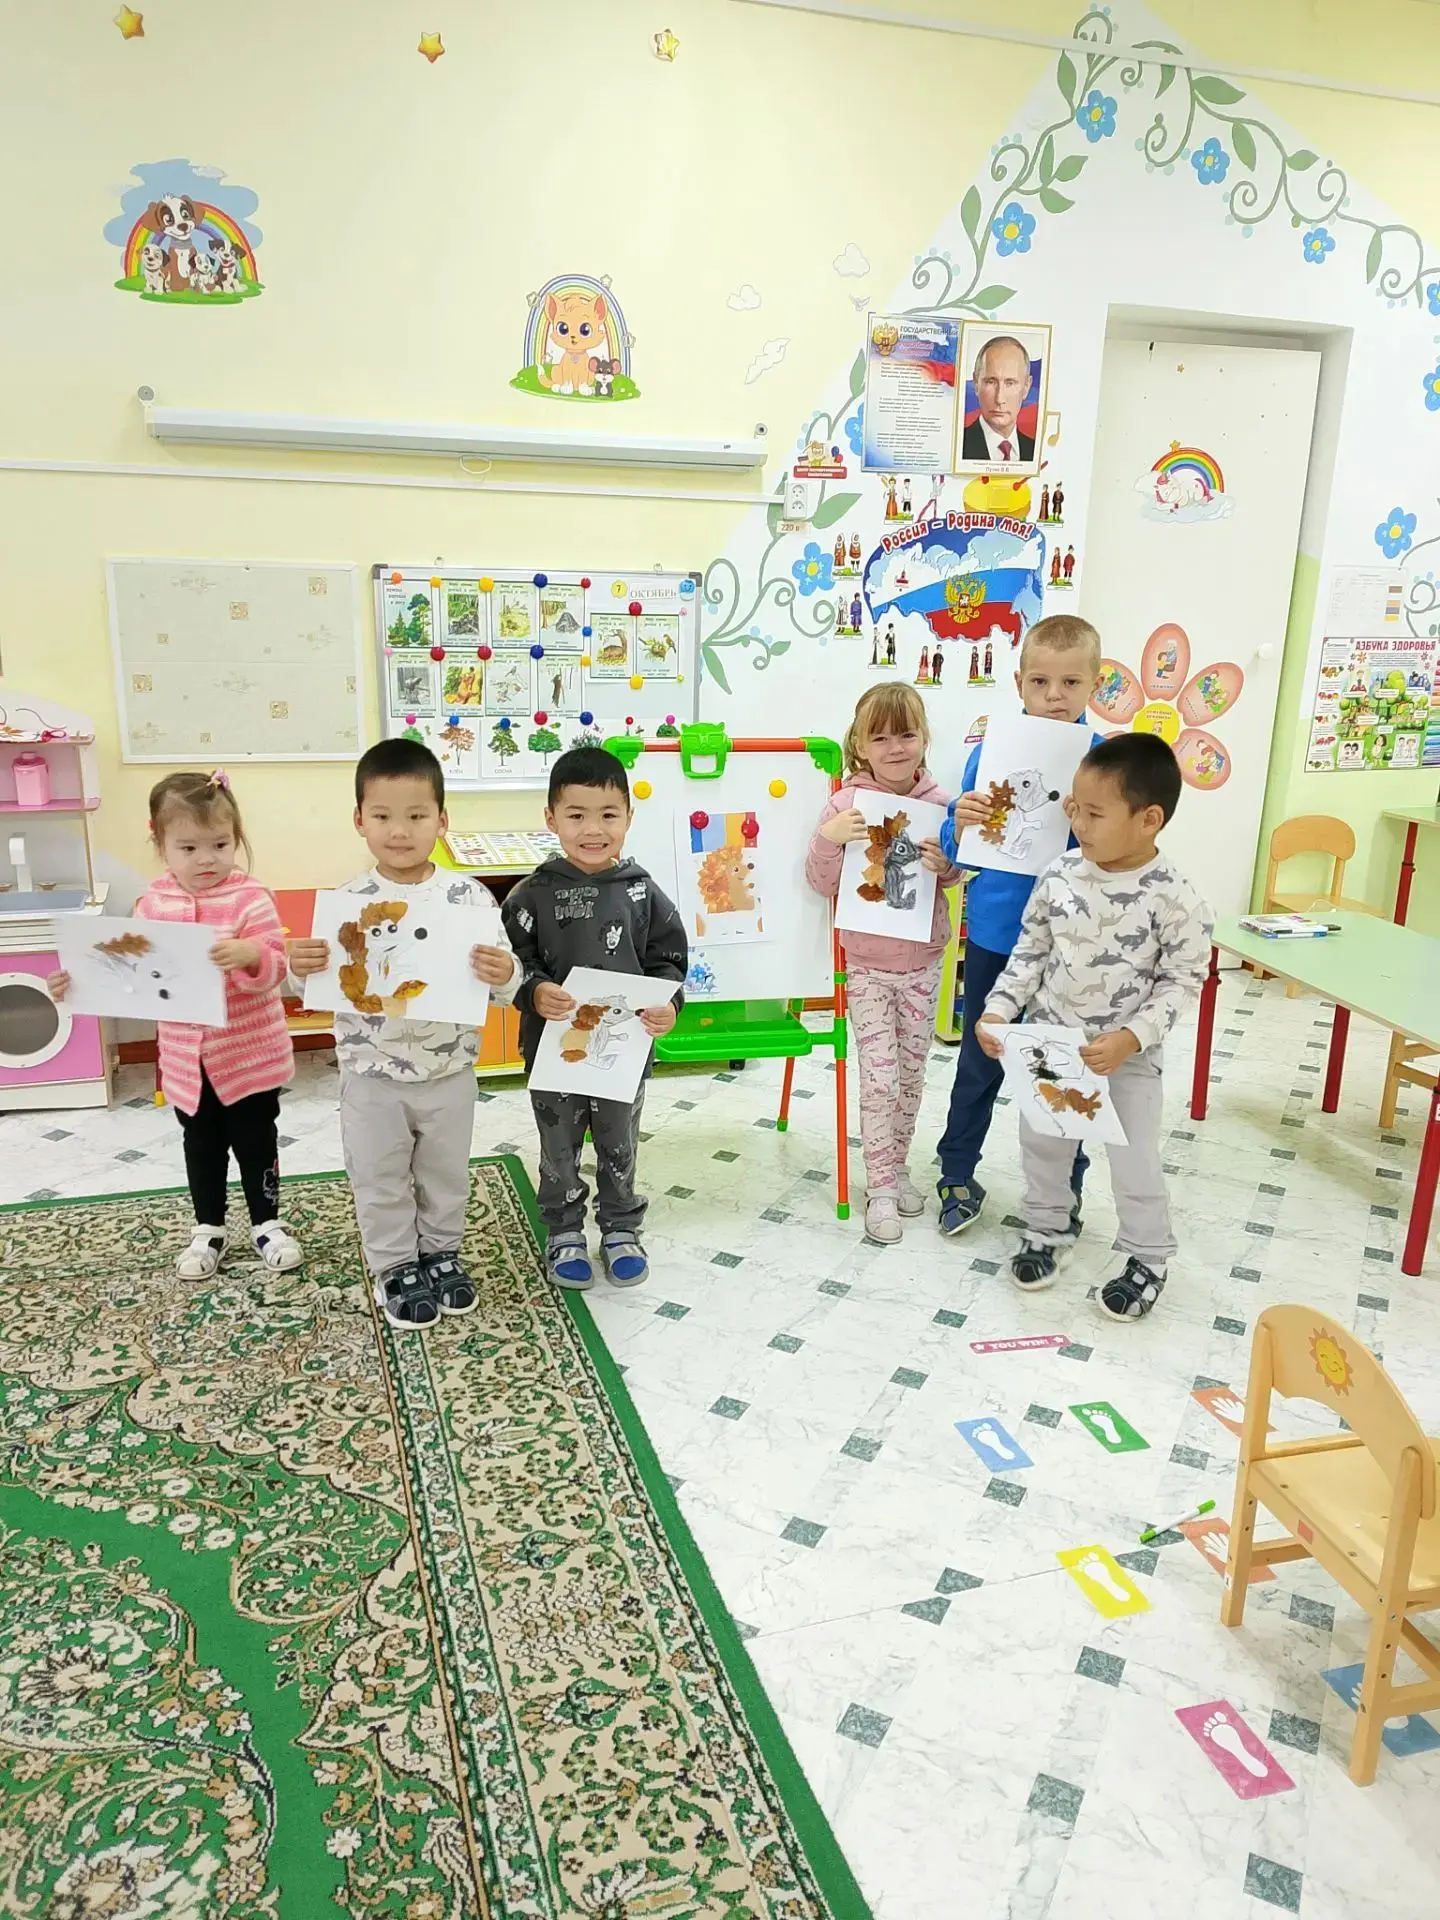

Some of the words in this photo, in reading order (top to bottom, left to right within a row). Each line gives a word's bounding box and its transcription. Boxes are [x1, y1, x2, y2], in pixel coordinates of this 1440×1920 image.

[781, 523, 793, 531] 220
[882, 521, 928, 552] Россия
[948, 512, 995, 531] Родина
[630, 589, 676, 598] ОКТЯБРЬ
[1356, 641, 1388, 650] АЗБУКА
[1392, 641, 1436, 651] ЗДОРОВЬЯ
